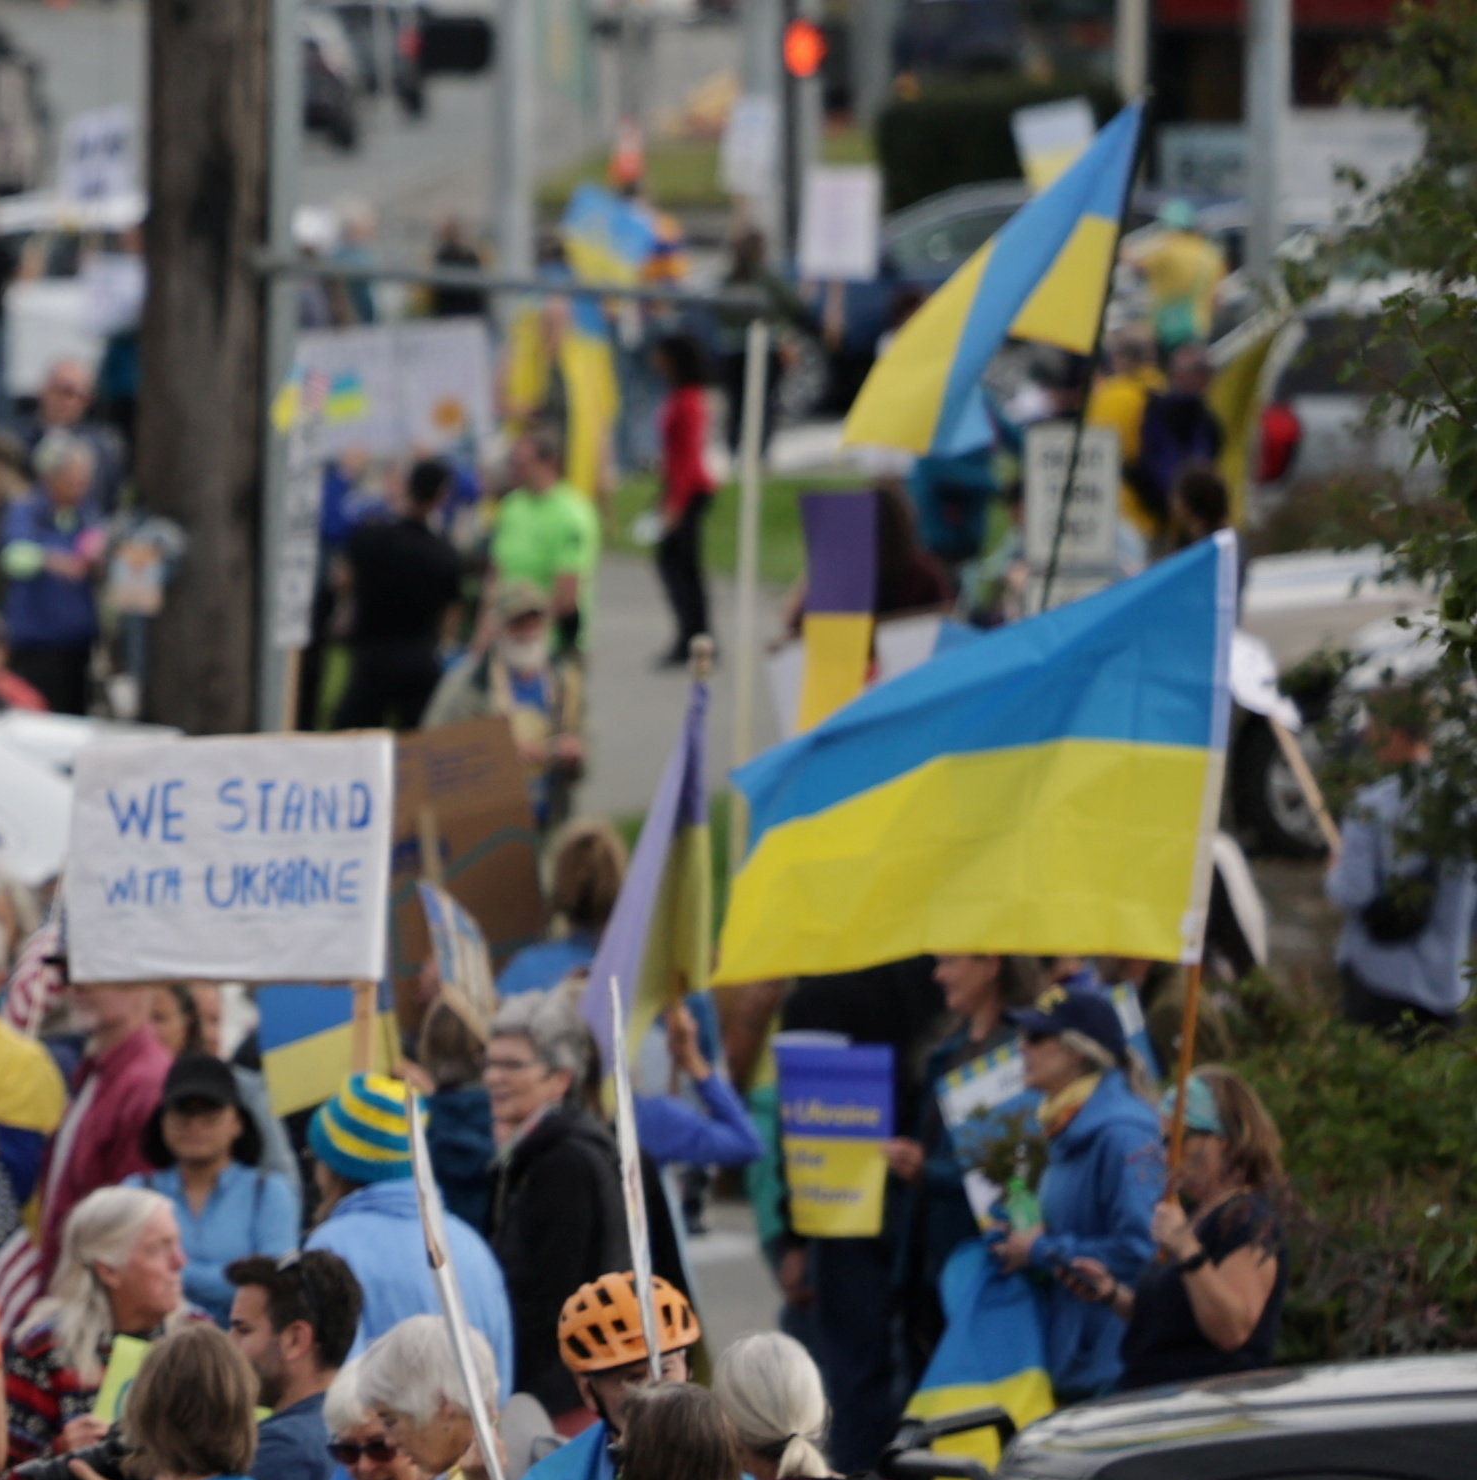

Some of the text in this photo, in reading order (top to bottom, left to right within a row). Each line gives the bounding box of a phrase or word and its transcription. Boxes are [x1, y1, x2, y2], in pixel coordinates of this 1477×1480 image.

[106, 778, 374, 841] WE STAND
[99, 857, 362, 908] WITH UKRAINE
